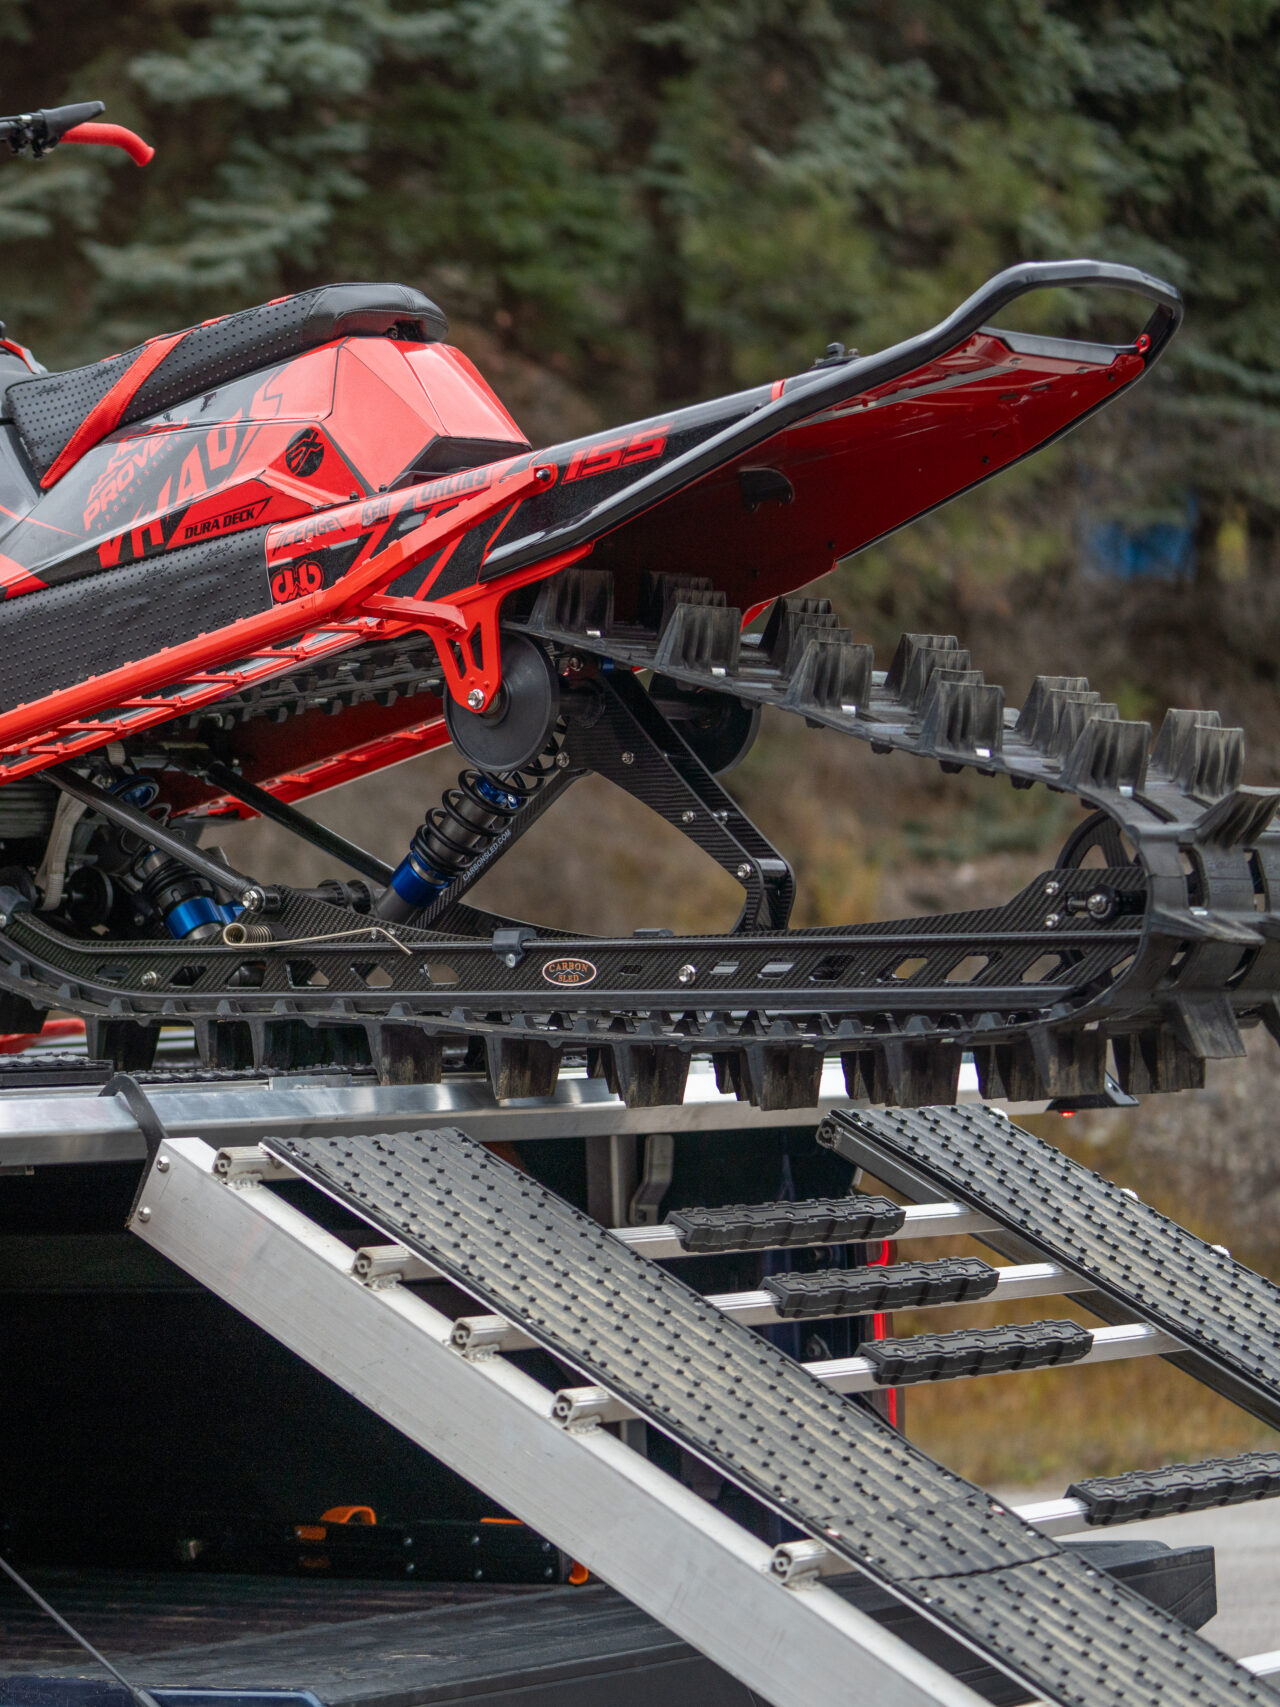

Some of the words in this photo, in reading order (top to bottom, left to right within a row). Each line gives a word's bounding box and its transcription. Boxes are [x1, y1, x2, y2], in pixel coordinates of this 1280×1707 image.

[561, 421, 675, 485] 155
[184, 519, 222, 540] DURA
[222, 507, 256, 528] DECK
[462, 828, 513, 881] CARBONSLED.COM
[548, 961, 589, 973] CARBON
[558, 974, 580, 983] SLED
